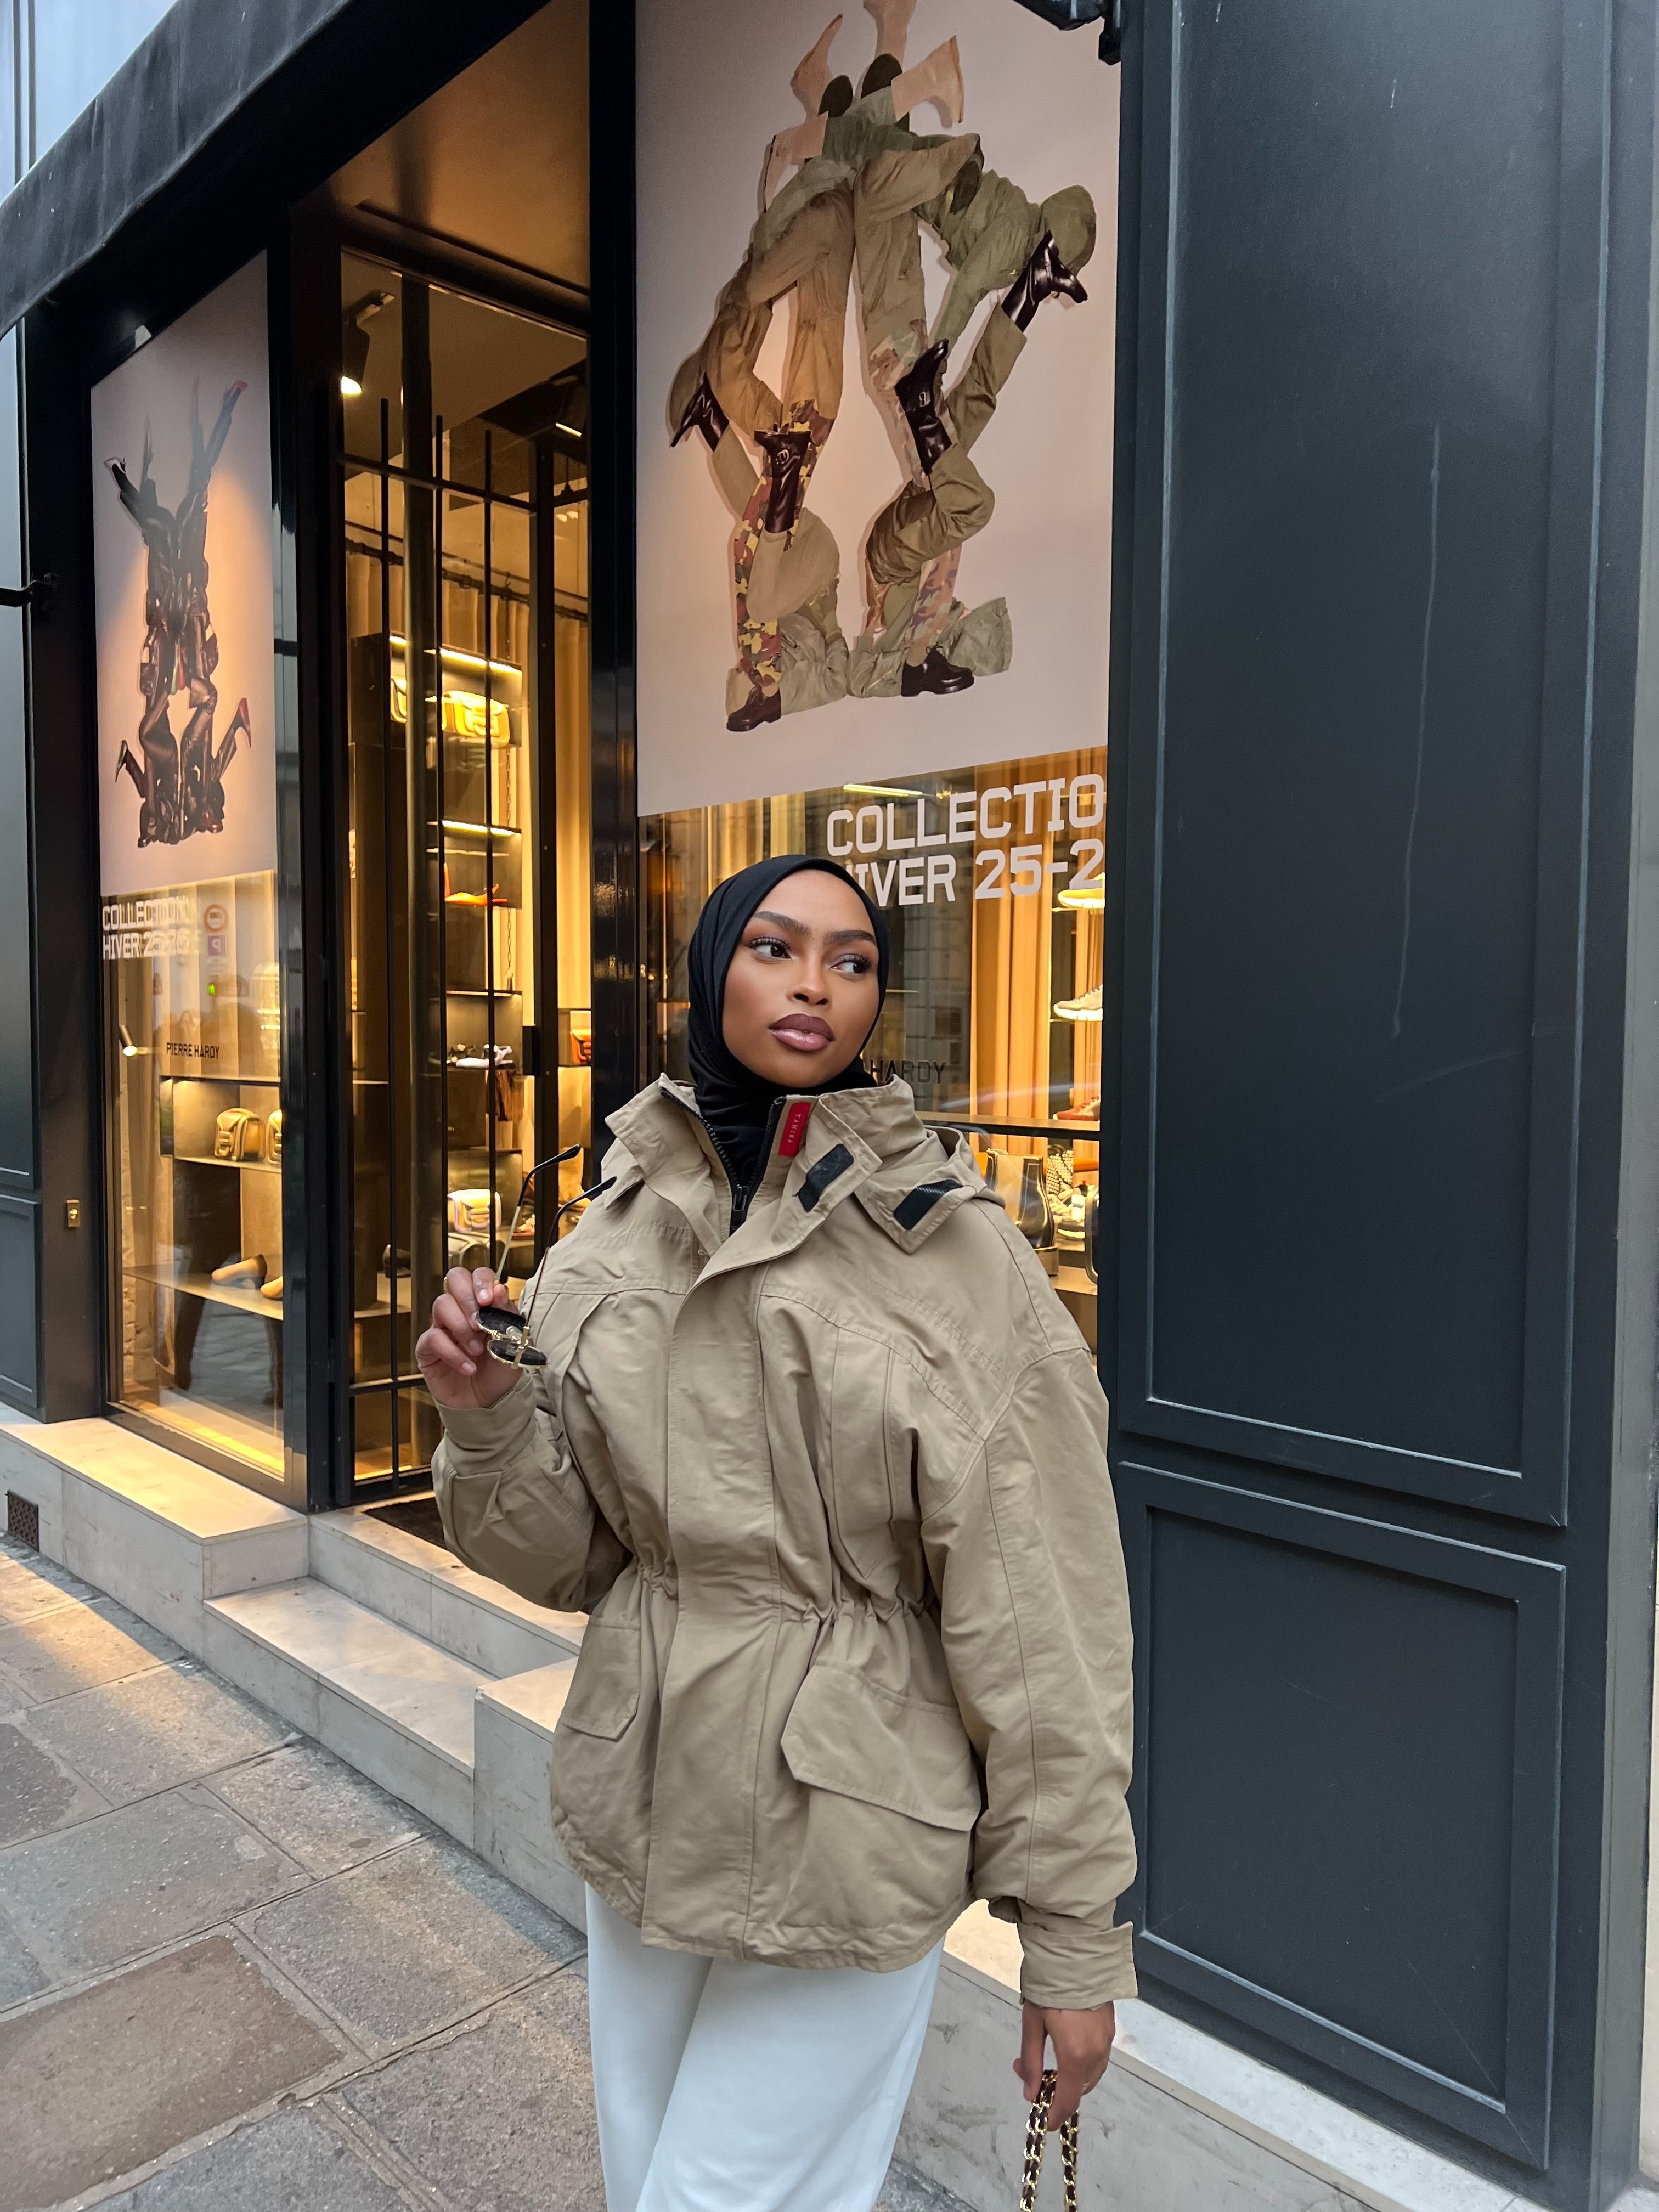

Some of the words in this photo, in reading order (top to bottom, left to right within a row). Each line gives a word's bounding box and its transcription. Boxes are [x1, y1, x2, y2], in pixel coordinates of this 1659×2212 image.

[827, 773, 1104, 856] COLLECTIO
[846, 854, 956, 907] IVER
[975, 838, 1104, 900] 25-2
[102, 896, 188, 931] COLLECTION
[102, 932, 139, 960] HIVER
[166, 1042, 192, 1057] PIERRE
[194, 1045, 219, 1059] HARDY
[870, 1059, 946, 1084] HARDY
